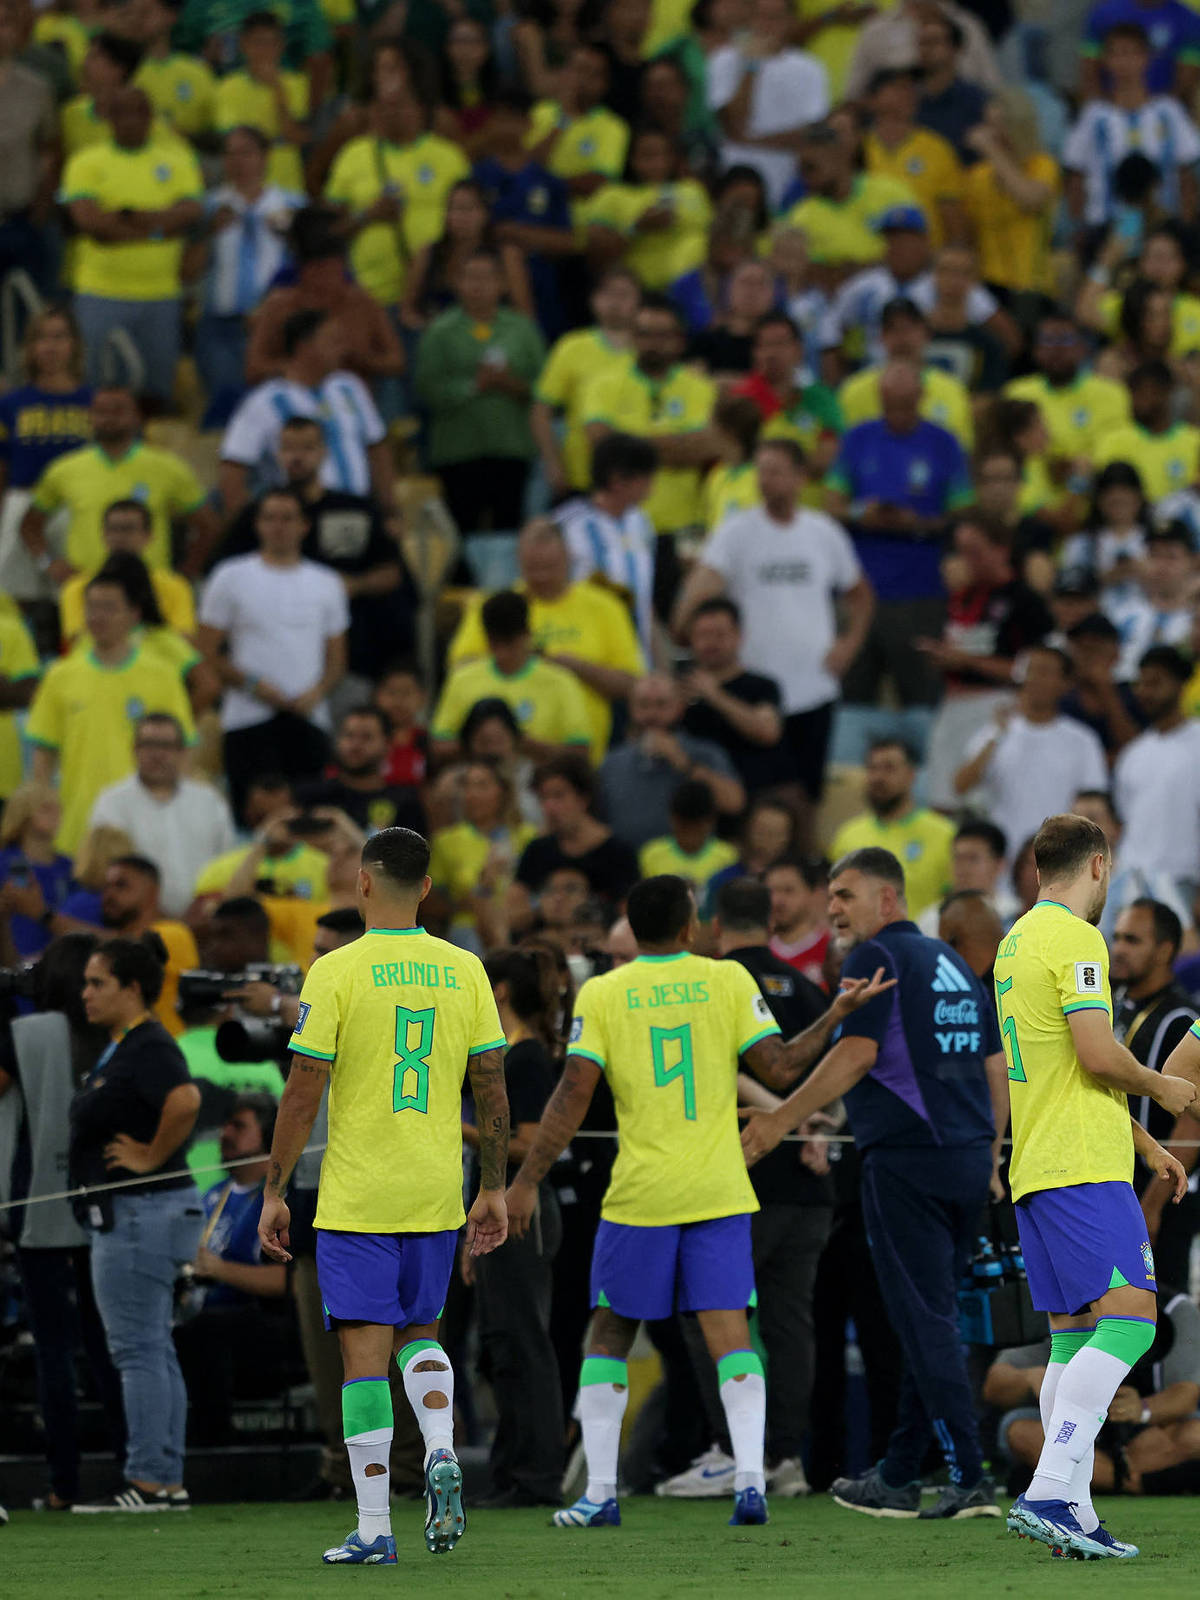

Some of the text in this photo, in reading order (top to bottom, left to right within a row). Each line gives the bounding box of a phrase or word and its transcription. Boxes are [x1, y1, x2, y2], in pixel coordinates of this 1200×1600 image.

[371, 961, 461, 990] BRUNO G.
[626, 981, 709, 1009] G. JESUS
[934, 1031, 981, 1054] YPF
[392, 1005, 436, 1114] 8
[649, 1022, 697, 1121] 9
